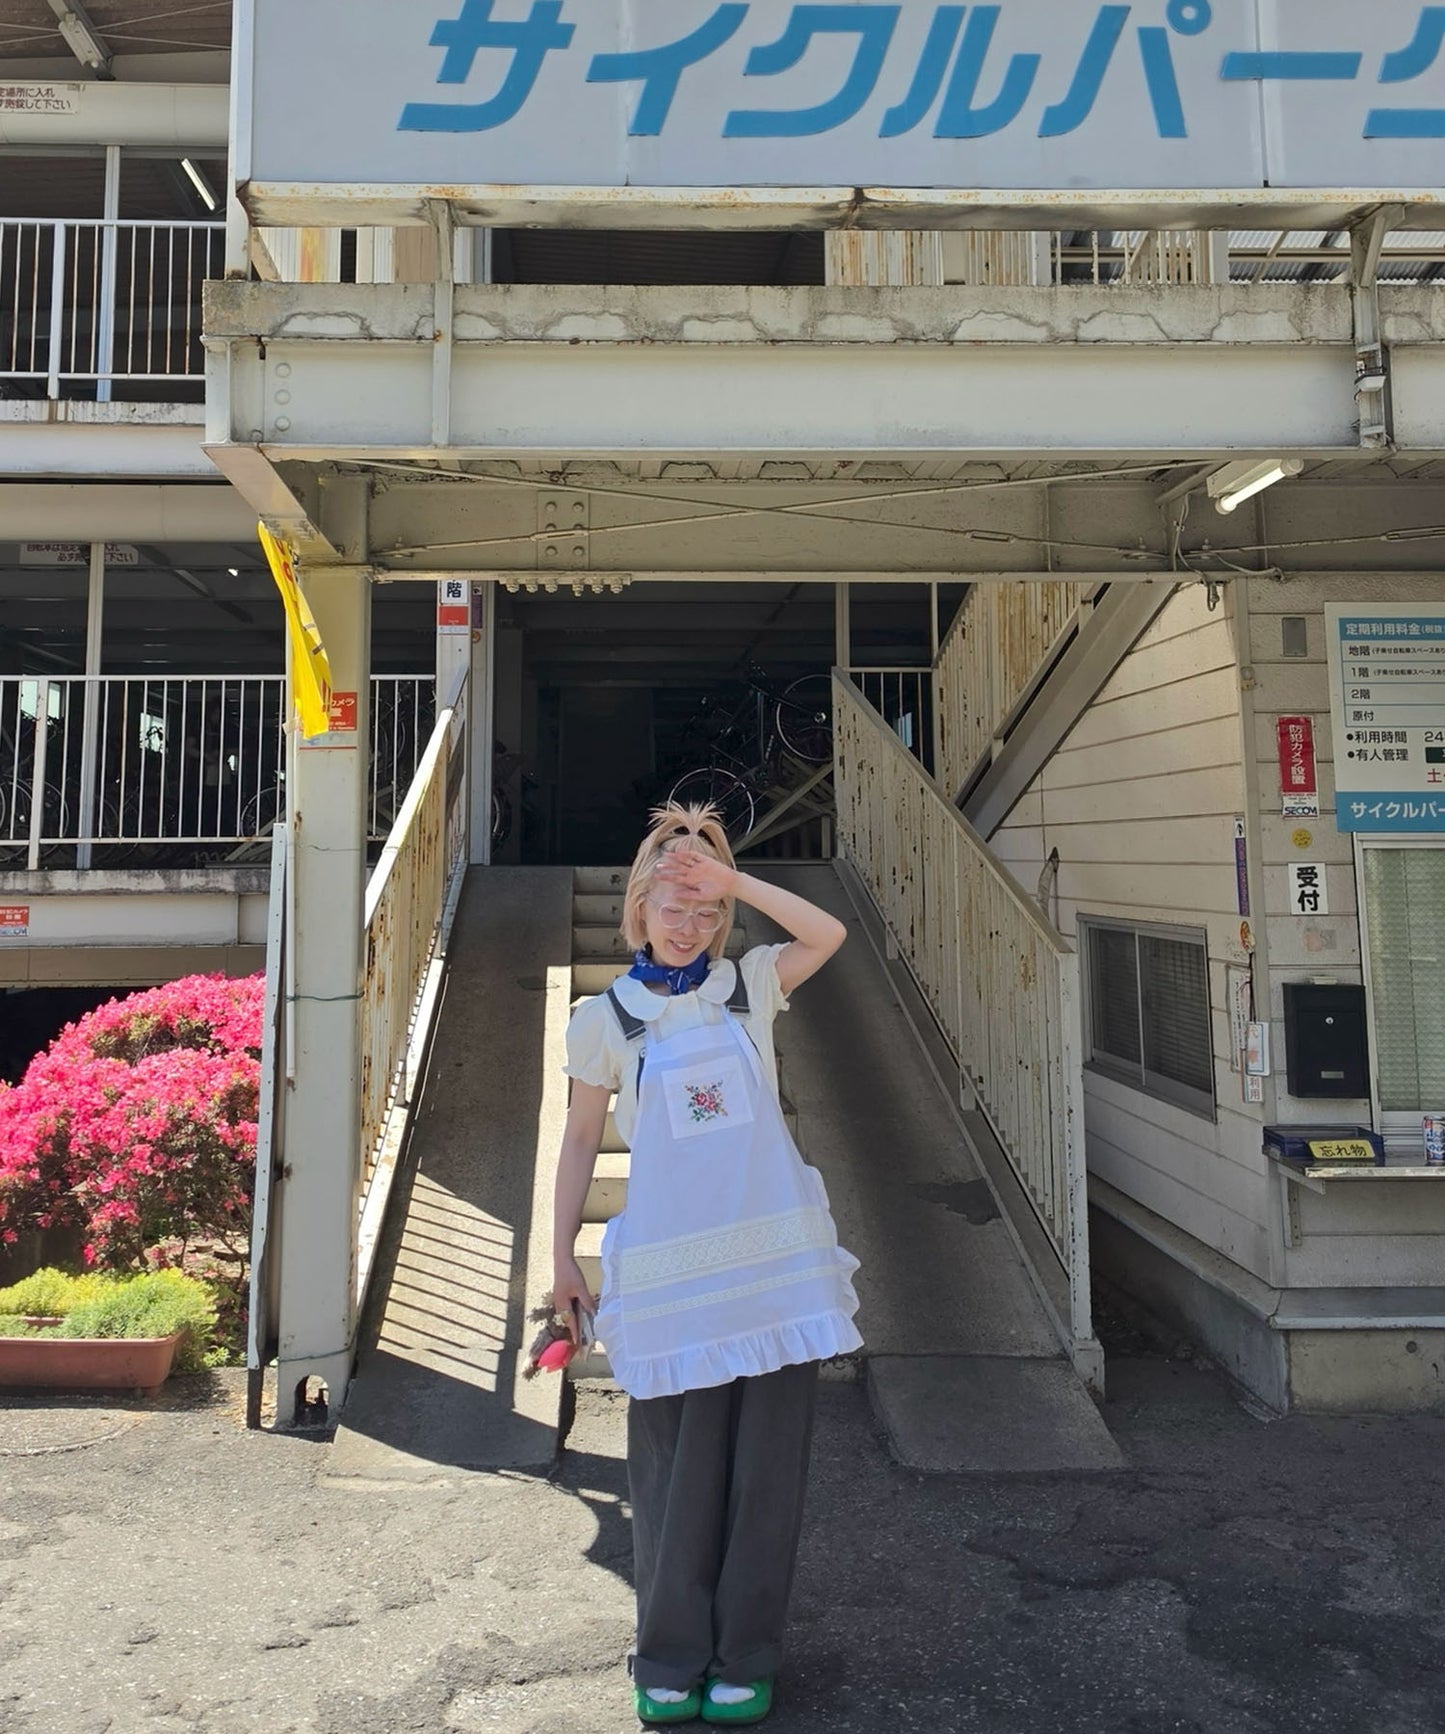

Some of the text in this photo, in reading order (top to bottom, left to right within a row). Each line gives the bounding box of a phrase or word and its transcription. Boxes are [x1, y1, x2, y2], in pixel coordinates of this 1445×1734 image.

[1348, 645, 1371, 657] 地階
[1351, 667, 1370, 678] 1階
[1351, 688, 1371, 700] 2階
[1353, 710, 1375, 722] 原付
[1354, 730, 1408, 744] 利用時間
[1288, 725, 1306, 785] 防犯カメラ設置
[1356, 748, 1409, 761] 有人管理
[1284, 806, 1318, 816] SECOM
[1296, 866, 1320, 912] 受付
[1319, 1144, 1368, 1157] 忘れ物
